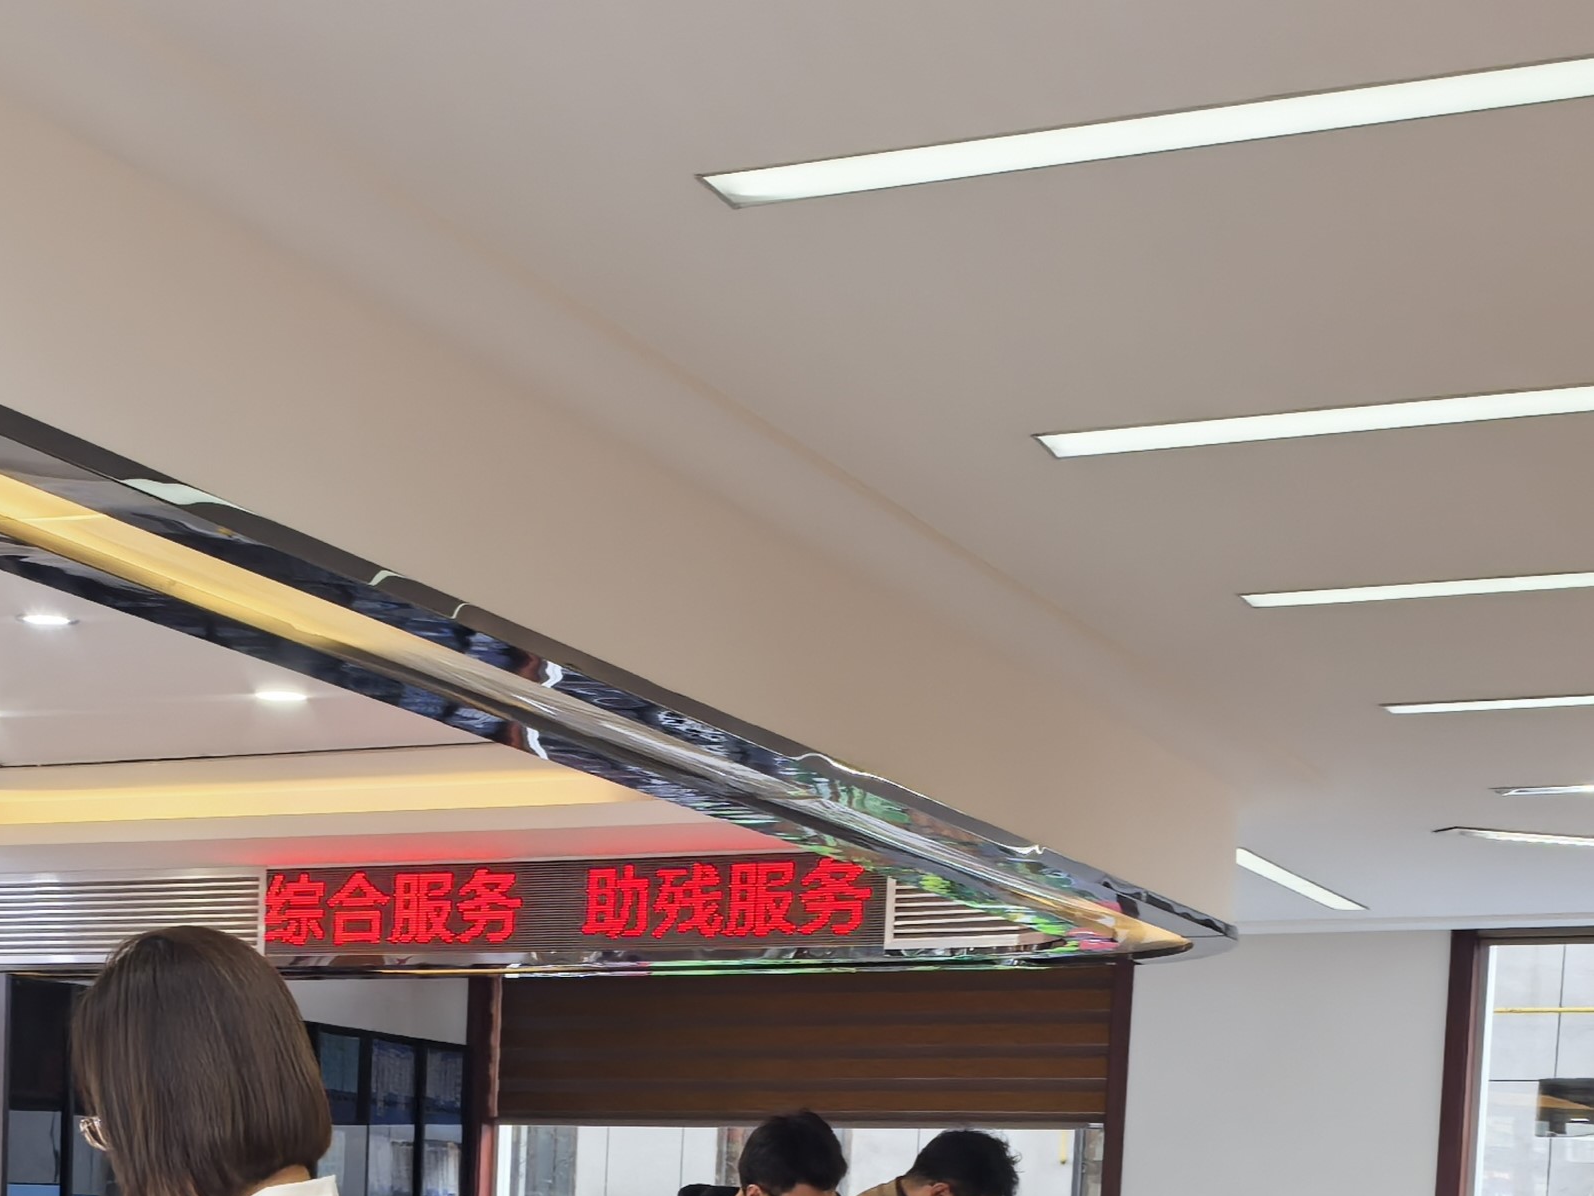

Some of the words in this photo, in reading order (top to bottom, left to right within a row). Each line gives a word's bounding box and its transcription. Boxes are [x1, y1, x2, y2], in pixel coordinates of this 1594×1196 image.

[264, 867, 523, 946] 综合服务
[581, 856, 872, 939] 助残服务
